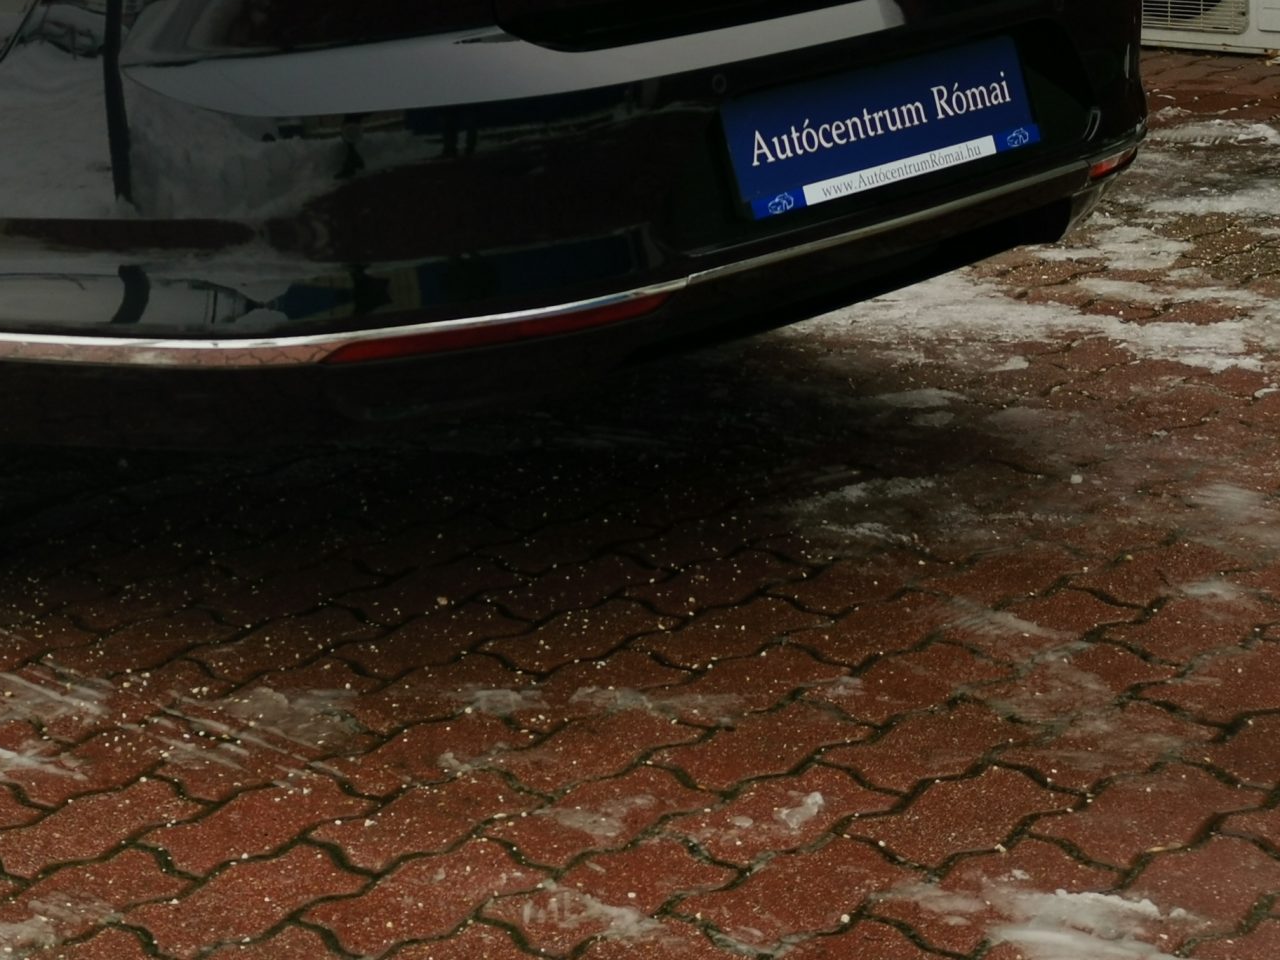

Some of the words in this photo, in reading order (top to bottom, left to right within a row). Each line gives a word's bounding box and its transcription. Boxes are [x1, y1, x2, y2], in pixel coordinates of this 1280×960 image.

[752, 100, 926, 166] Autócentrum
[930, 71, 1011, 120] Római
[821, 141, 982, 199] www.AutócentrumRómai.hu
